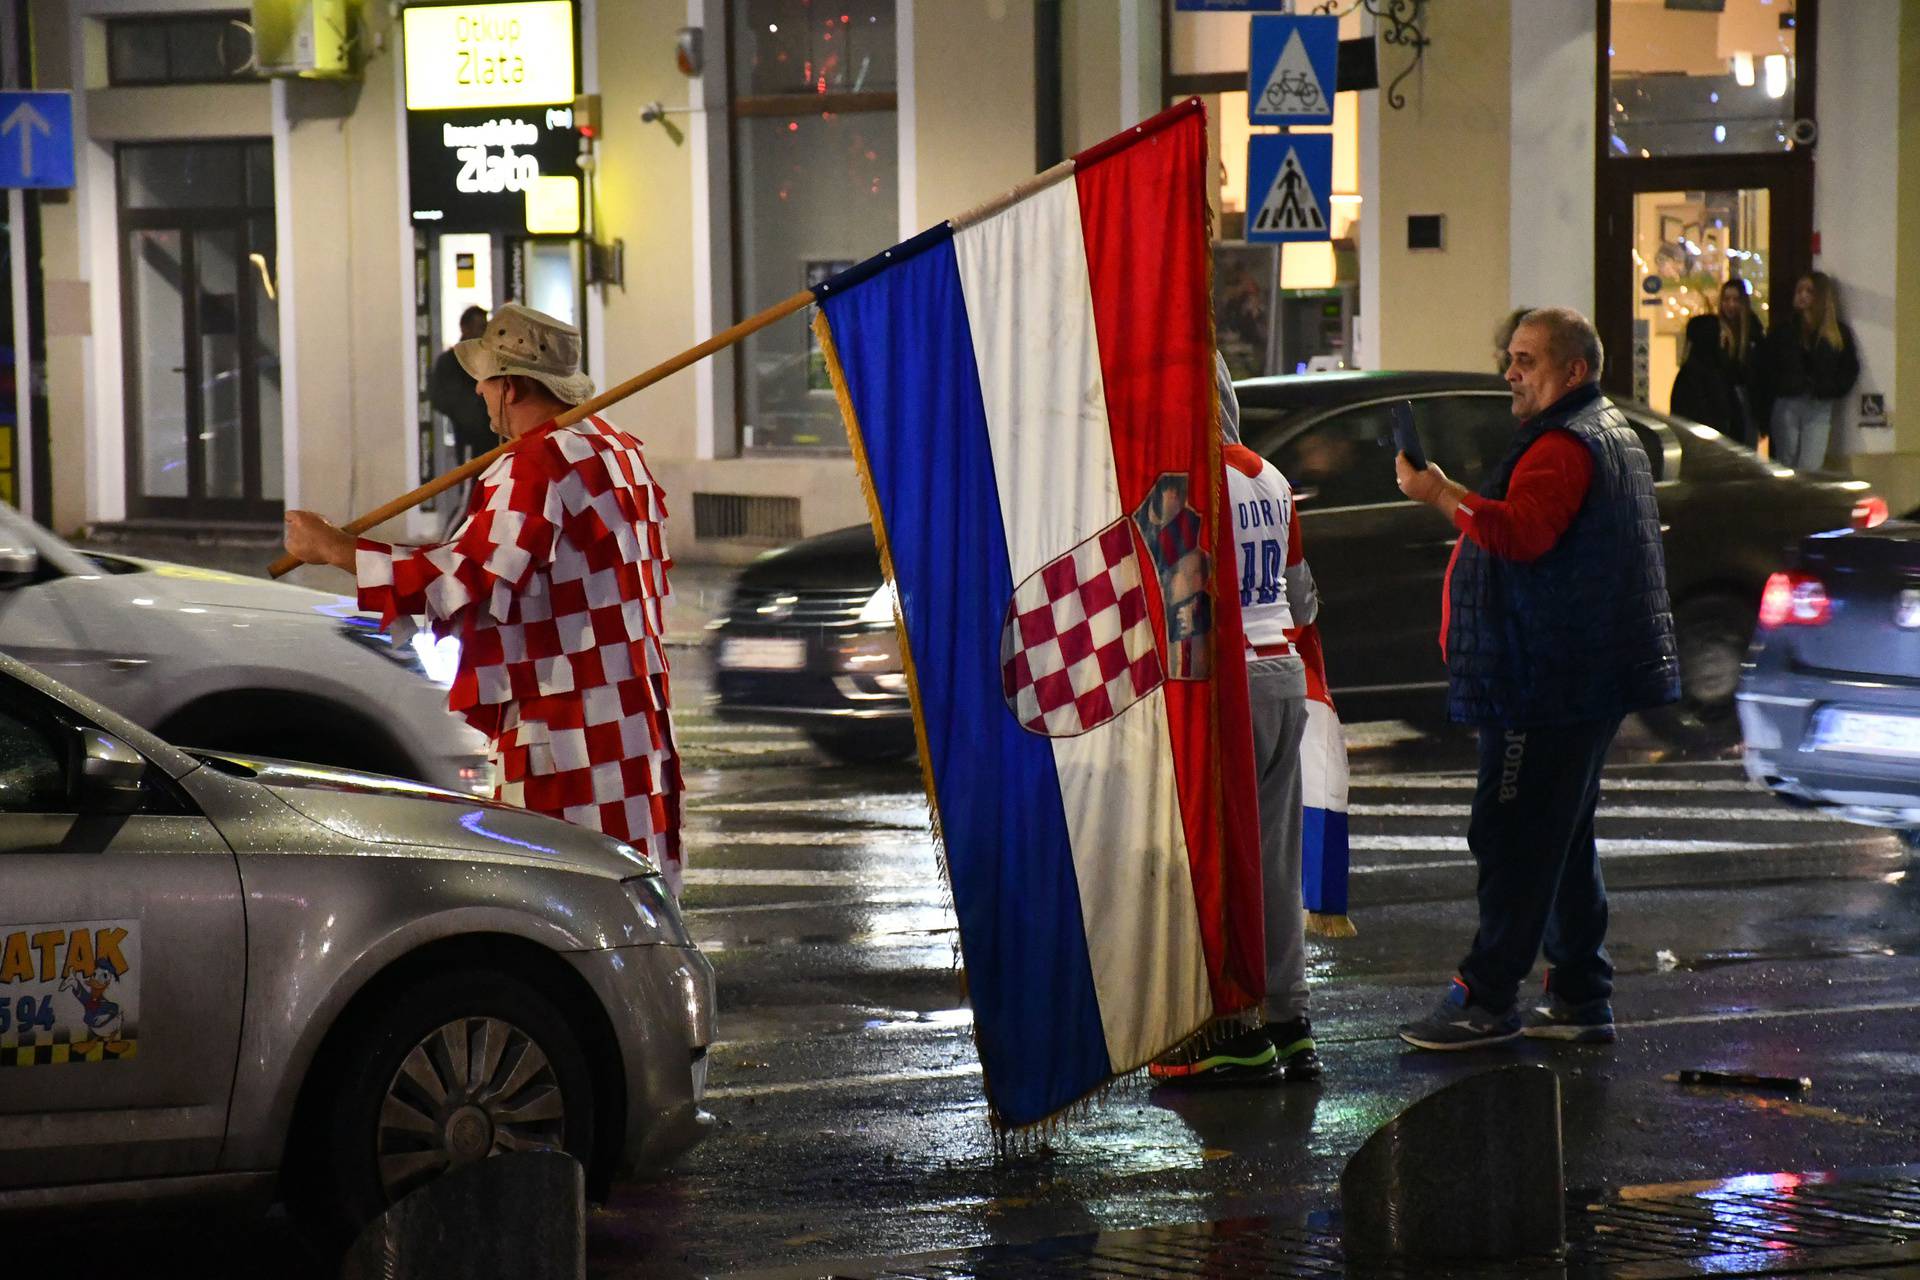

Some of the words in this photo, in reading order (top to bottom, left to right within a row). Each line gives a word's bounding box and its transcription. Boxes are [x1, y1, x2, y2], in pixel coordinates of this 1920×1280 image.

[456, 16, 522, 48] Otkup
[457, 48, 526, 85] Zlata
[456, 145, 539, 193] Zlato
[1240, 538, 1281, 607] 10
[1499, 729, 1527, 804] Joma
[0, 926, 129, 985] ATAK
